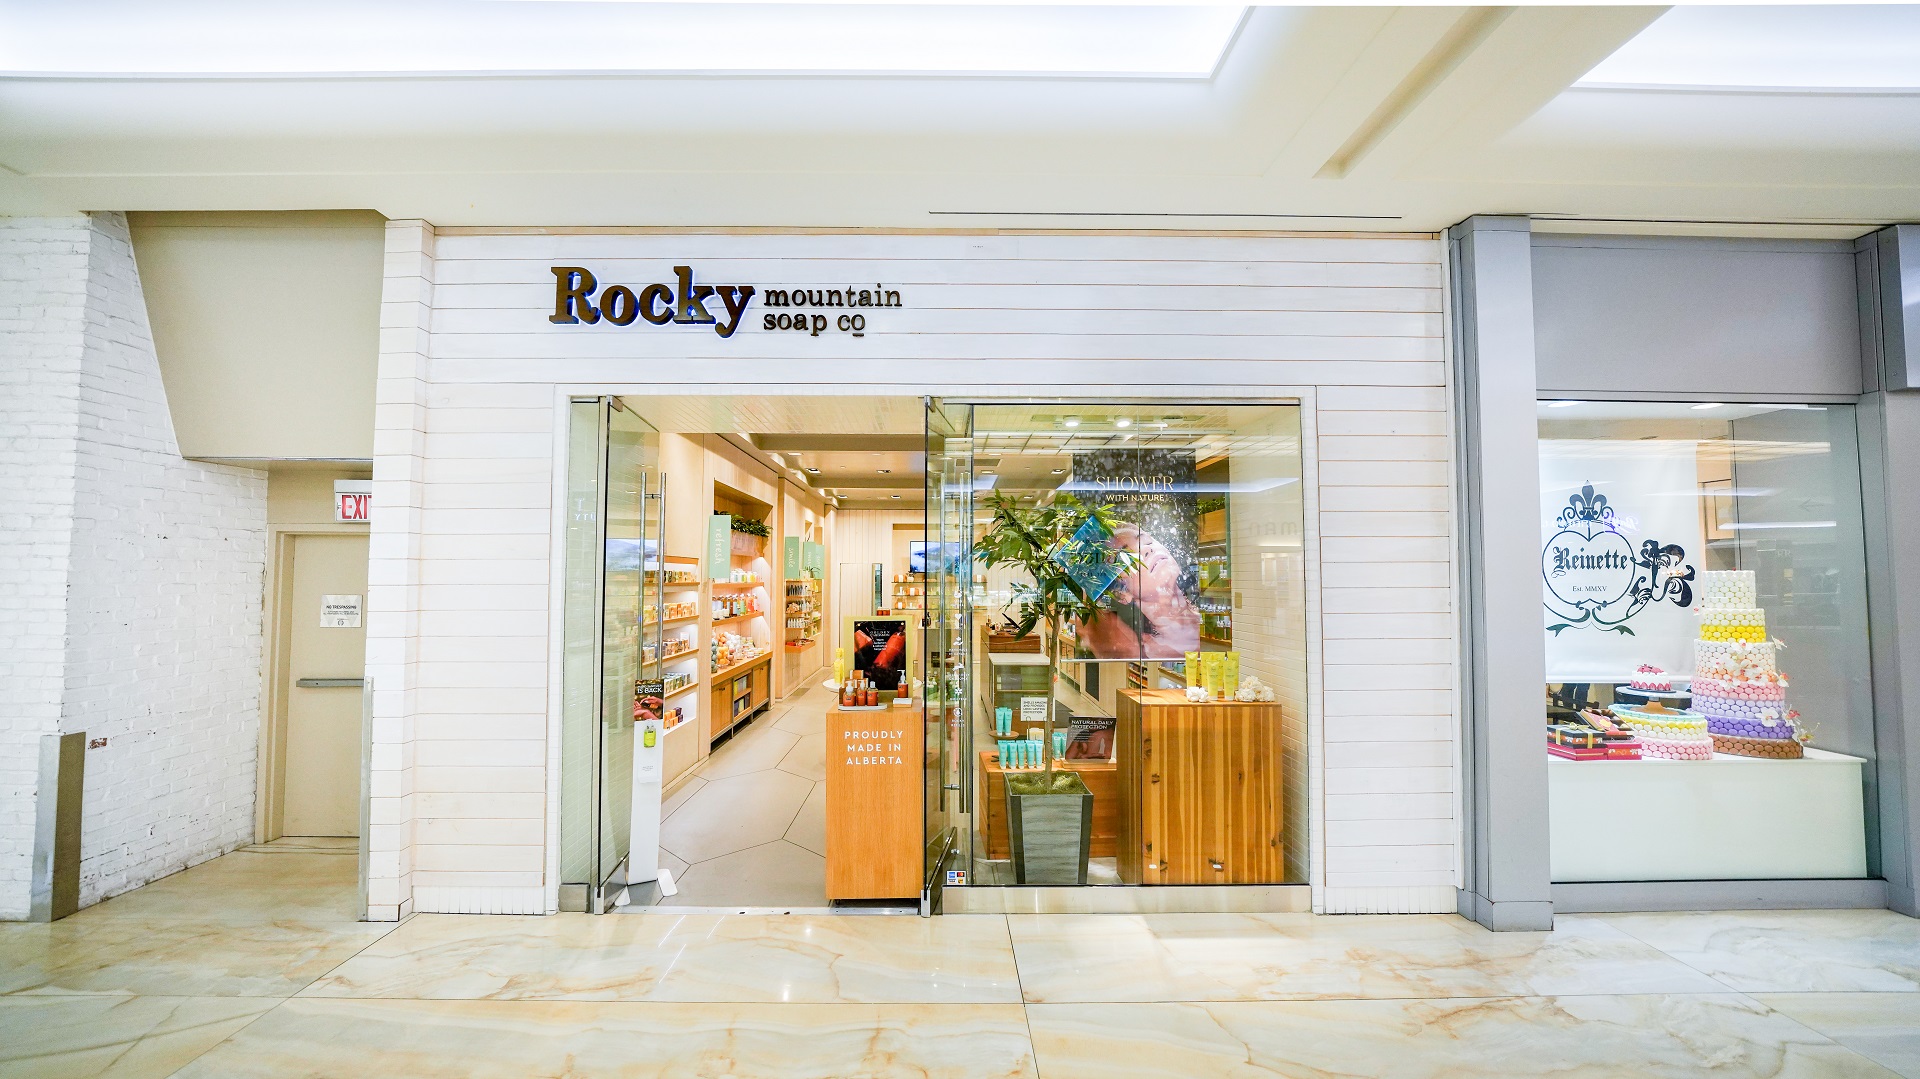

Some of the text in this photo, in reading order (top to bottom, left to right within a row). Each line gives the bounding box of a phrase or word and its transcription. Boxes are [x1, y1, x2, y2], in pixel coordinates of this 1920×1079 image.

[549, 266, 755, 339] Rocky
[764, 283, 902, 308] mountain
[763, 312, 866, 337] soap co
[1096, 475, 1174, 491] SHOWER
[1106, 494, 1164, 502] WITH NATURE
[714, 528, 725, 565] refresh
[1551, 546, 1628, 579] Reinette
[845, 731, 903, 740] PROUDLY
[847, 744, 901, 752] MADE IN
[846, 756, 903, 765] ALBERTA
